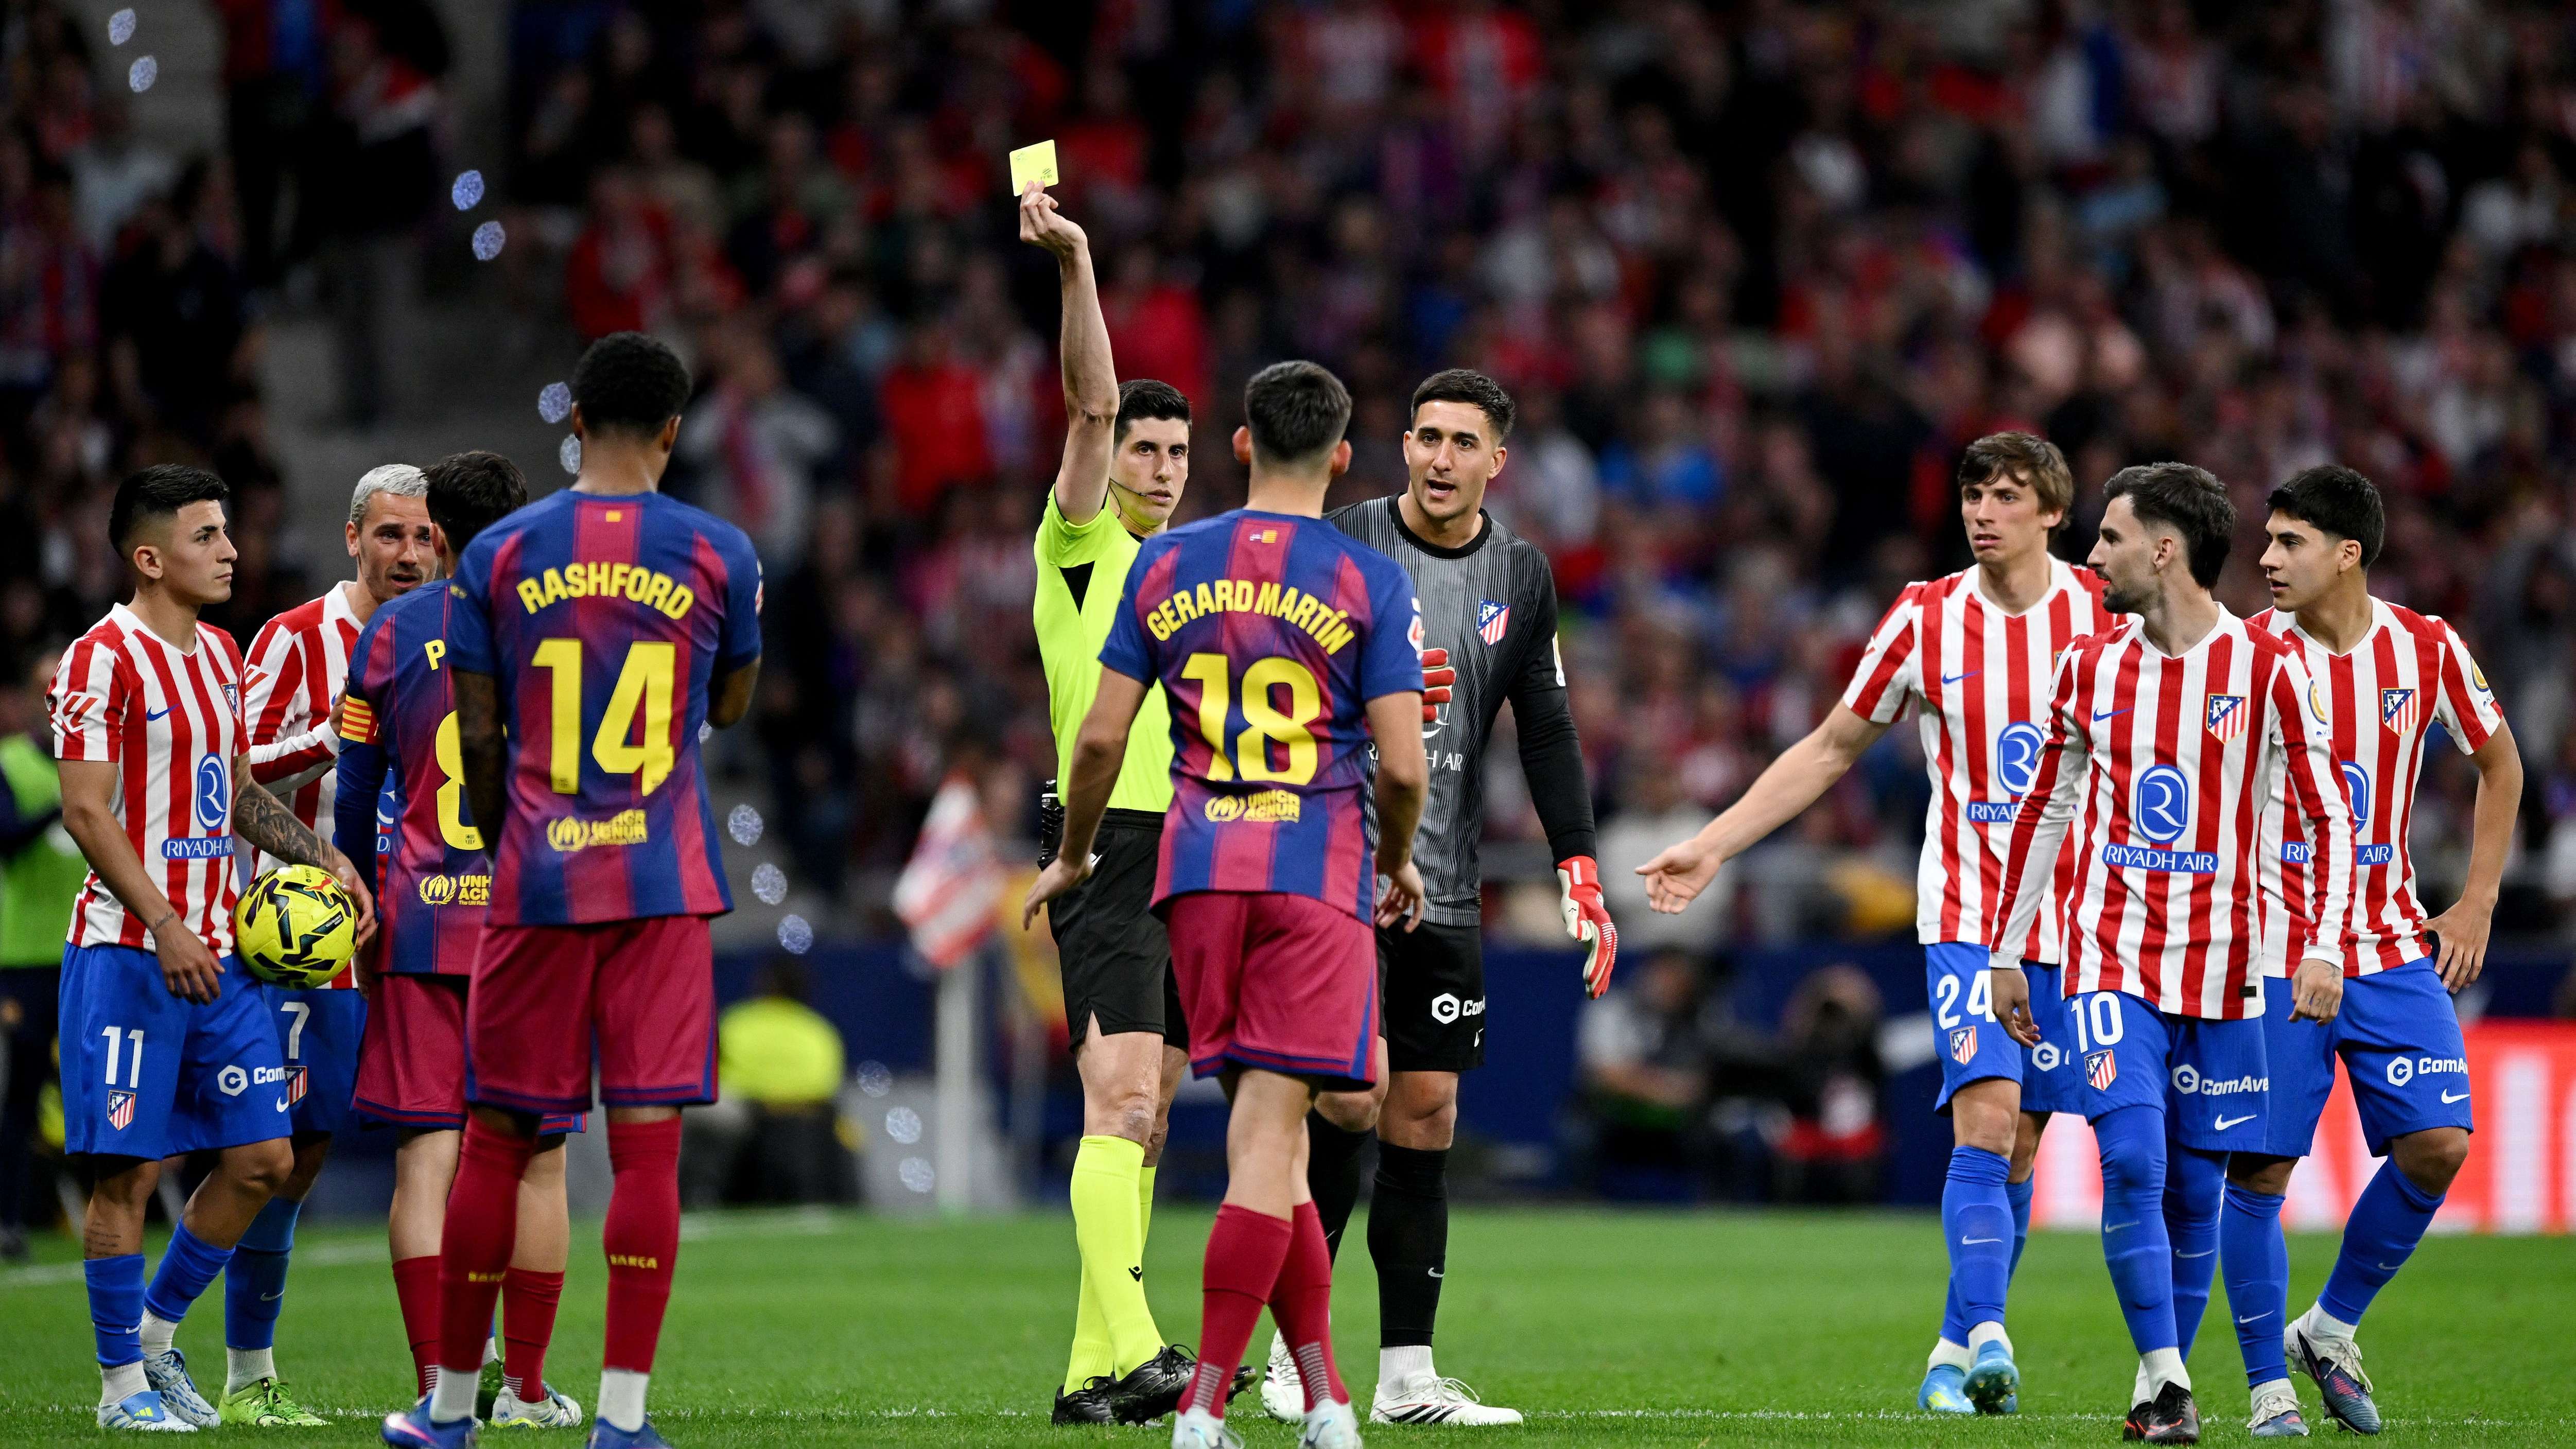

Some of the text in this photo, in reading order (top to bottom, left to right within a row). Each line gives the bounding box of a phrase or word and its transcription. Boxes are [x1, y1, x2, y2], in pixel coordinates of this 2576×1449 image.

[516, 561, 694, 620] RASHFORD
[1146, 580, 1355, 655] GERARD MARTÍN
[531, 637, 675, 796] 14
[1180, 652, 1321, 785] 18
[167, 839, 222, 857] RIYADH
[2105, 845, 2214, 871] RIYADH AIR
[2362, 846, 2389, 863] AIR
[459, 875, 492, 887] UNH
[1937, 970, 1996, 1030] 24
[2070, 991, 2124, 1054] 10
[101, 1025, 144, 1088] 11
[281, 1002, 310, 1059] 7
